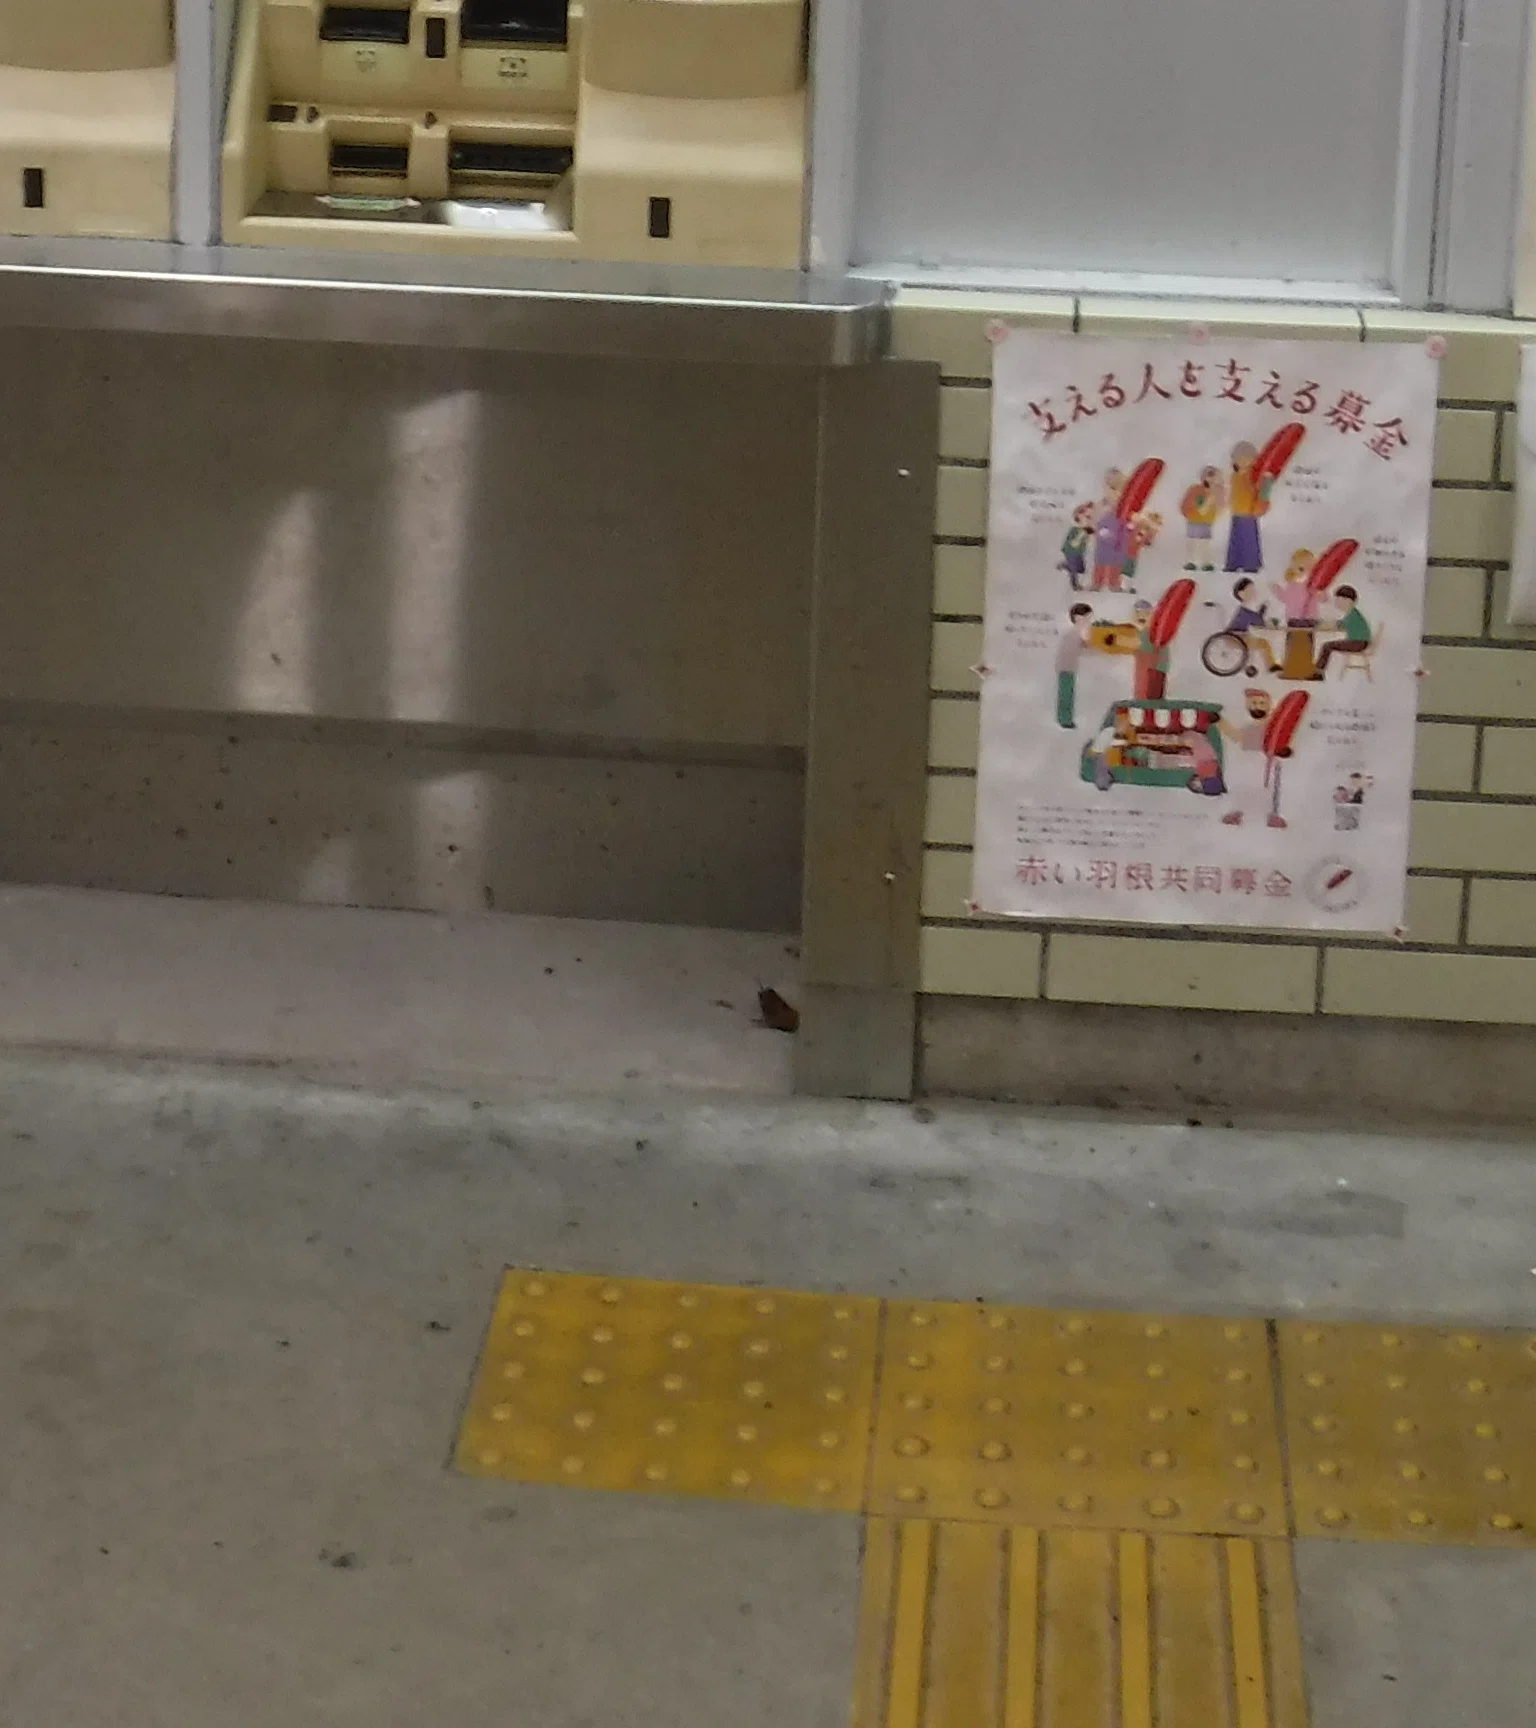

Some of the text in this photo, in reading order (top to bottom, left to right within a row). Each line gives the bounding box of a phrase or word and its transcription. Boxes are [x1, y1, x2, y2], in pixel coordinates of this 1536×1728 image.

[1027, 358, 1411, 461] 支える人を支える募金
[1014, 855, 1294, 900] 赤い羽根共同募金
